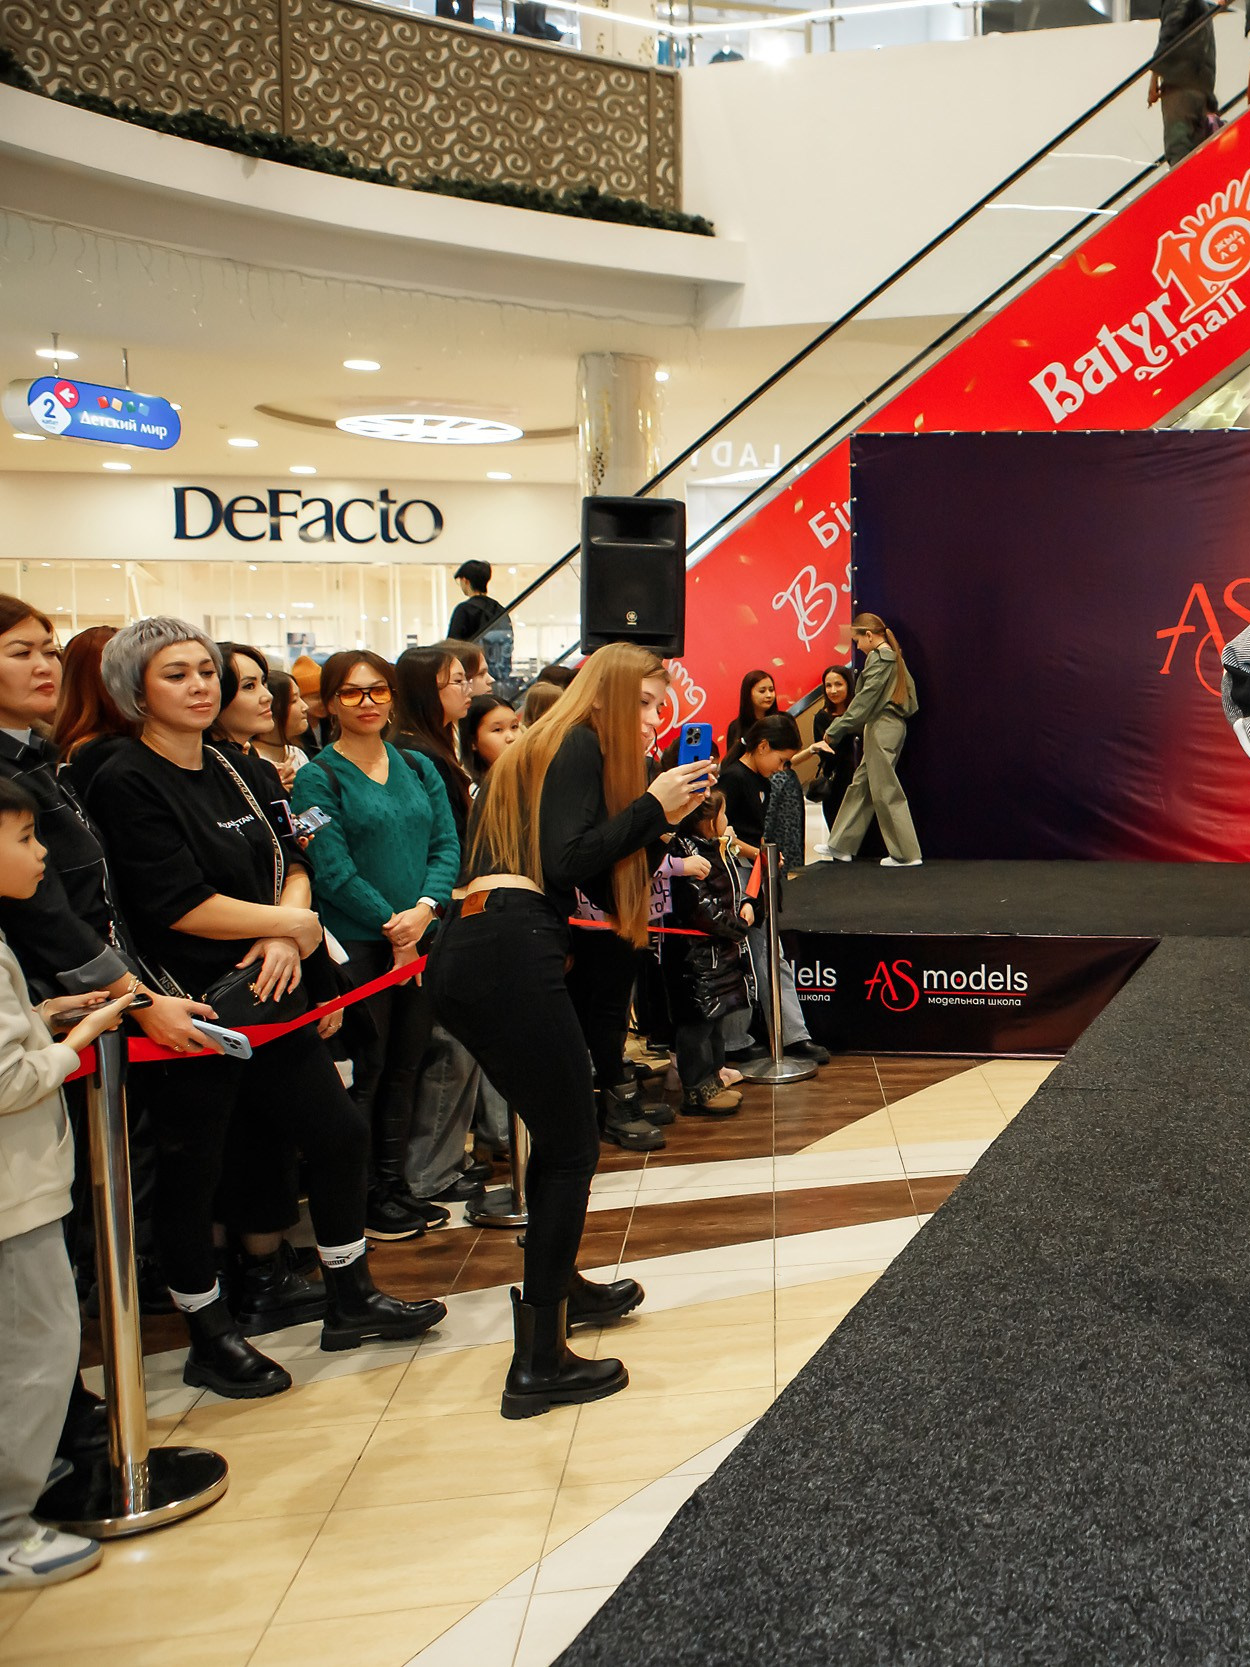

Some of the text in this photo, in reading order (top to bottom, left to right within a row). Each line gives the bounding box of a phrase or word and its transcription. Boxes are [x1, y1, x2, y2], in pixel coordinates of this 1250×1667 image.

[1171, 288, 1247, 357] mall
[1029, 292, 1177, 424] Batyr
[43, 398, 56, 419] 2
[79, 411, 137, 432] Детский
[140, 425, 168, 440] мир
[173, 486, 443, 544] DeFacto
[864, 959, 1028, 1012] AS models
[928, 997, 1022, 1008] модельная школа
